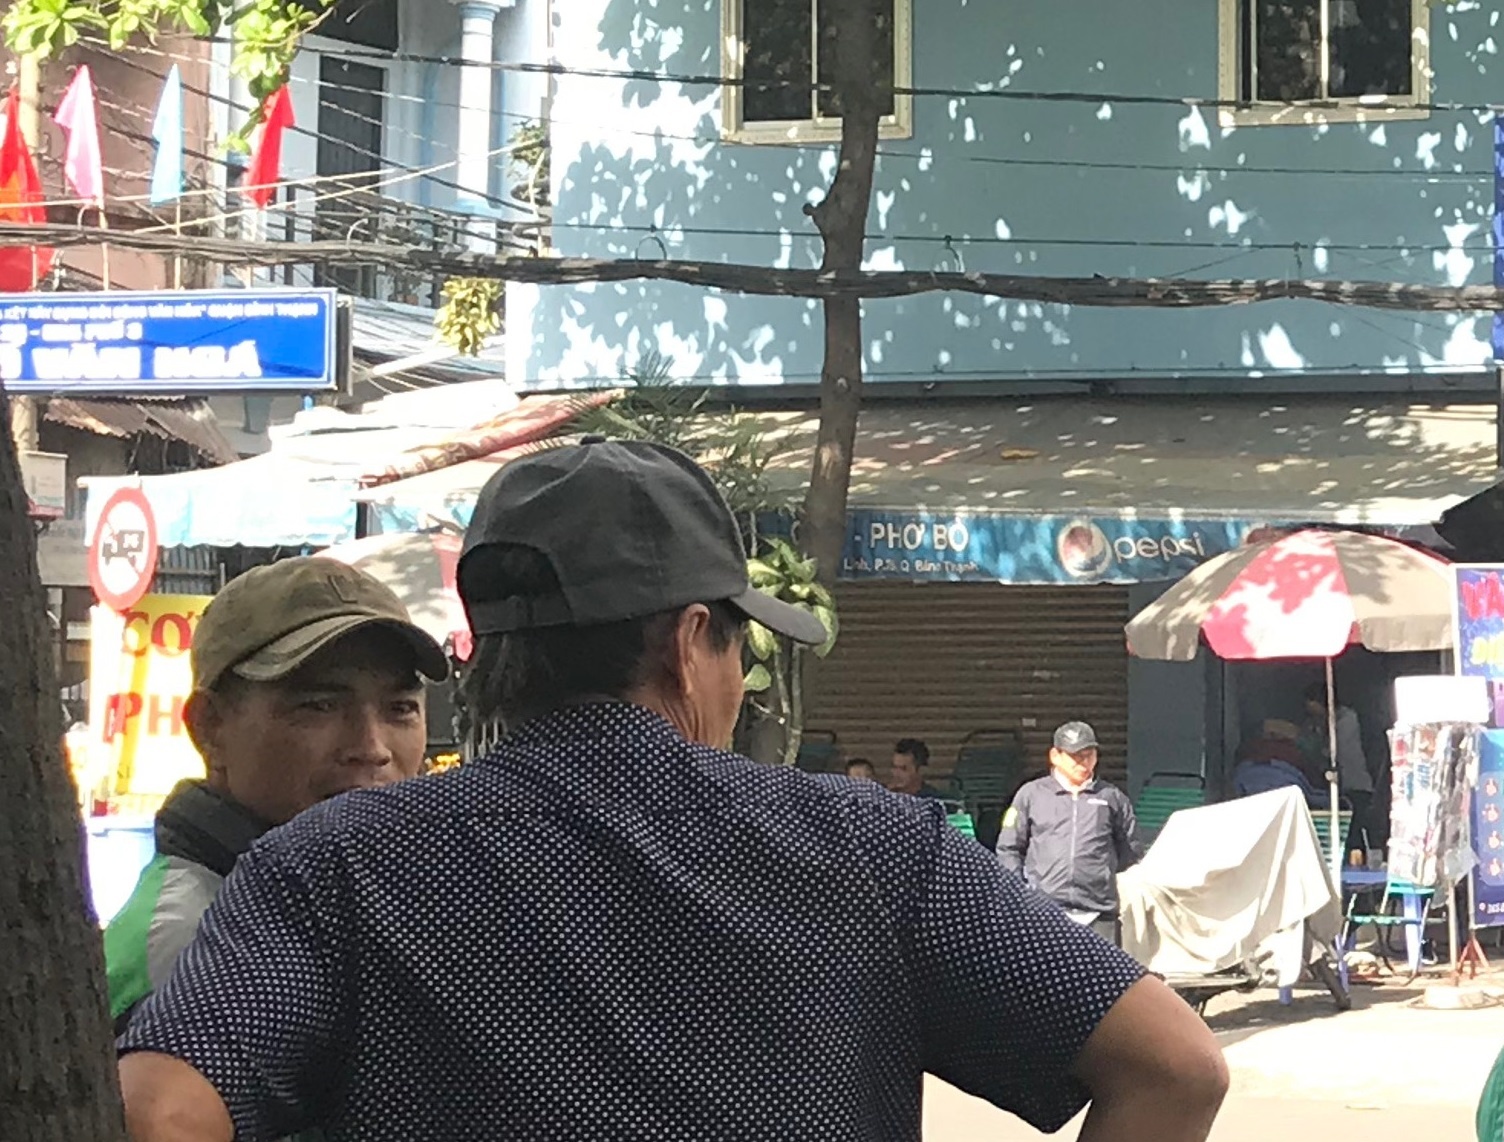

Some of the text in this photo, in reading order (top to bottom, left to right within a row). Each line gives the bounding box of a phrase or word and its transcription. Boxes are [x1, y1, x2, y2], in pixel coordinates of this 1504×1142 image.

[1111, 530, 1205, 565] pepsi
[121, 609, 195, 658] CƠ
[105, 692, 184, 743] PH
